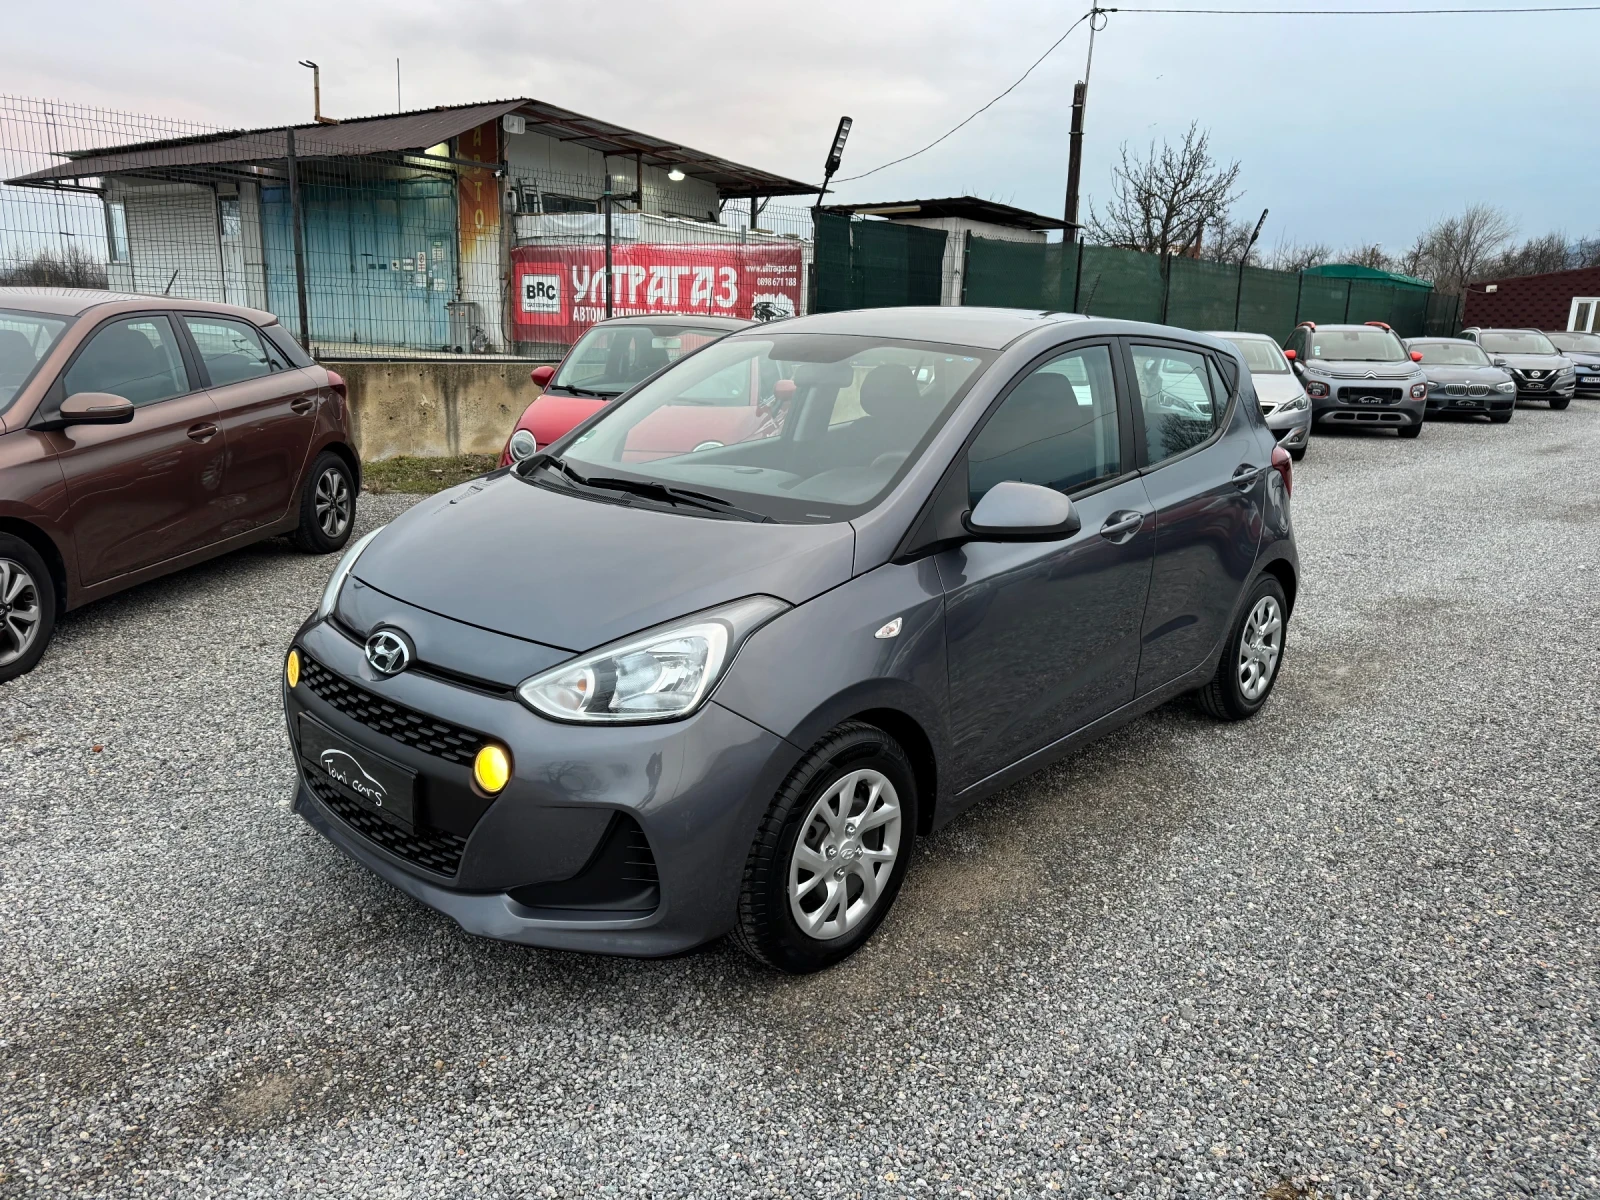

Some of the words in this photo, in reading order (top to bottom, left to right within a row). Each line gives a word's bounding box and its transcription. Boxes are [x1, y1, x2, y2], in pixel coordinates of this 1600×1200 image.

[745, 263, 797, 274] www.ultragas.eu
[526, 281, 556, 300] BRC
[572, 265, 738, 308] УЛТРАГАЗ
[772, 278, 784, 286] 671
[324, 759, 348, 785] Toni
[352, 779, 382, 807] cars
